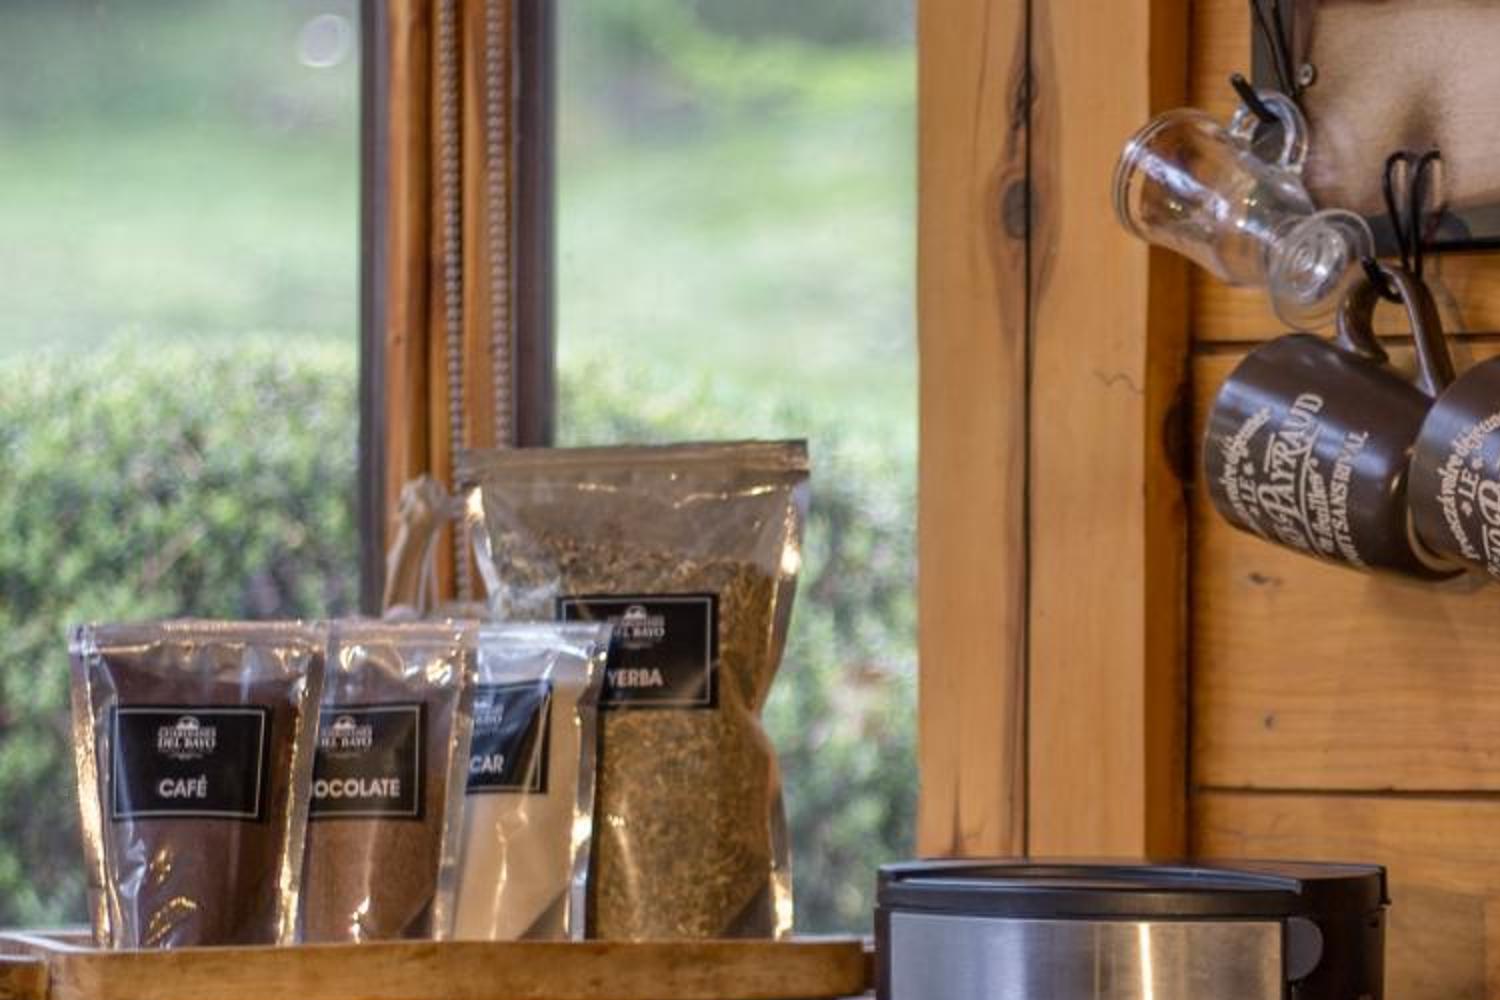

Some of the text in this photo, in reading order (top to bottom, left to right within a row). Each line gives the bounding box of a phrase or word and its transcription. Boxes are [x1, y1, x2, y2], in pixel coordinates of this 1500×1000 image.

[1238, 475, 1258, 506] LE
[1458, 469, 1482, 500] LE
[607, 668, 665, 688] YERBA
[159, 774, 207, 798] CAFÉ
[314, 778, 401, 798] OCOLATE
